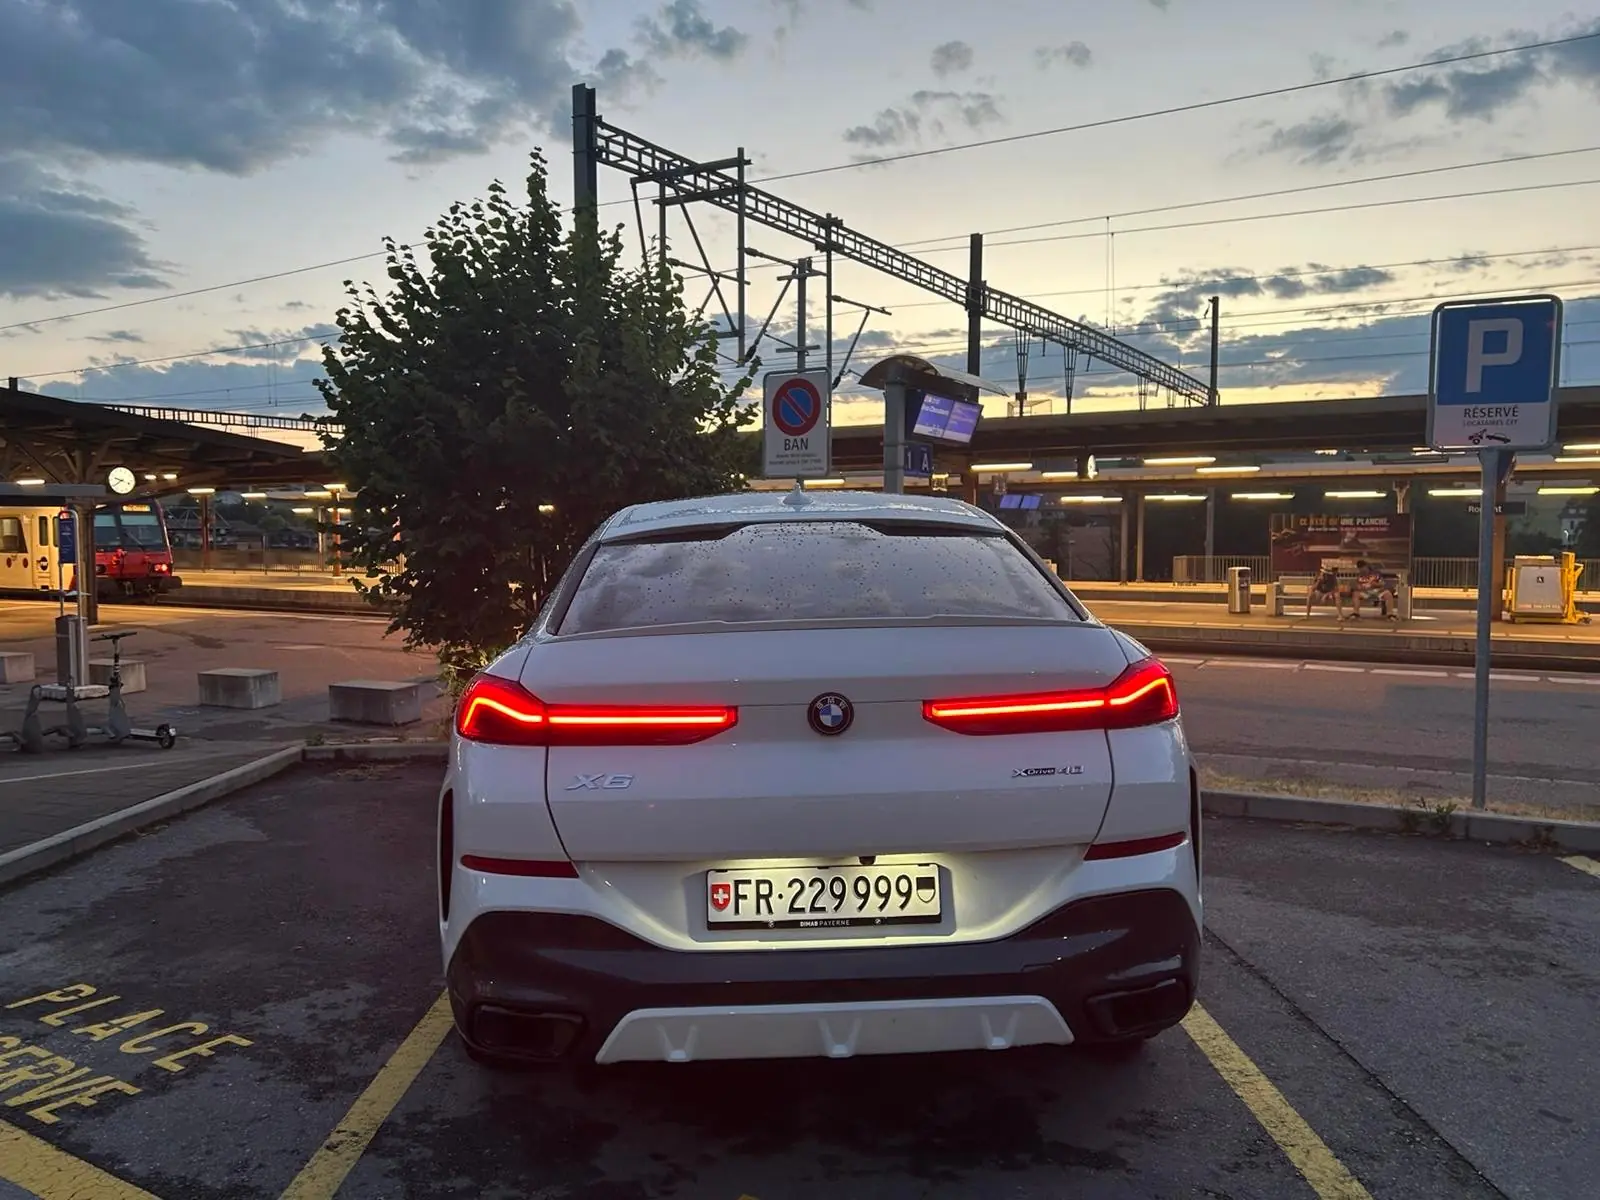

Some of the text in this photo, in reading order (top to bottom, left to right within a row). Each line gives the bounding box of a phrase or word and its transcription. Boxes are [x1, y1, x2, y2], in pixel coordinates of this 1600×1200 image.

[1465, 317, 1524, 393] P
[1463, 405, 1519, 418] RÉSERVÉ
[784, 438, 809, 451] BAN
[921, 452, 930, 472] A
[816, 696, 846, 709] BMW
[565, 773, 635, 790] X6
[4, 983, 254, 1073] PLACE
